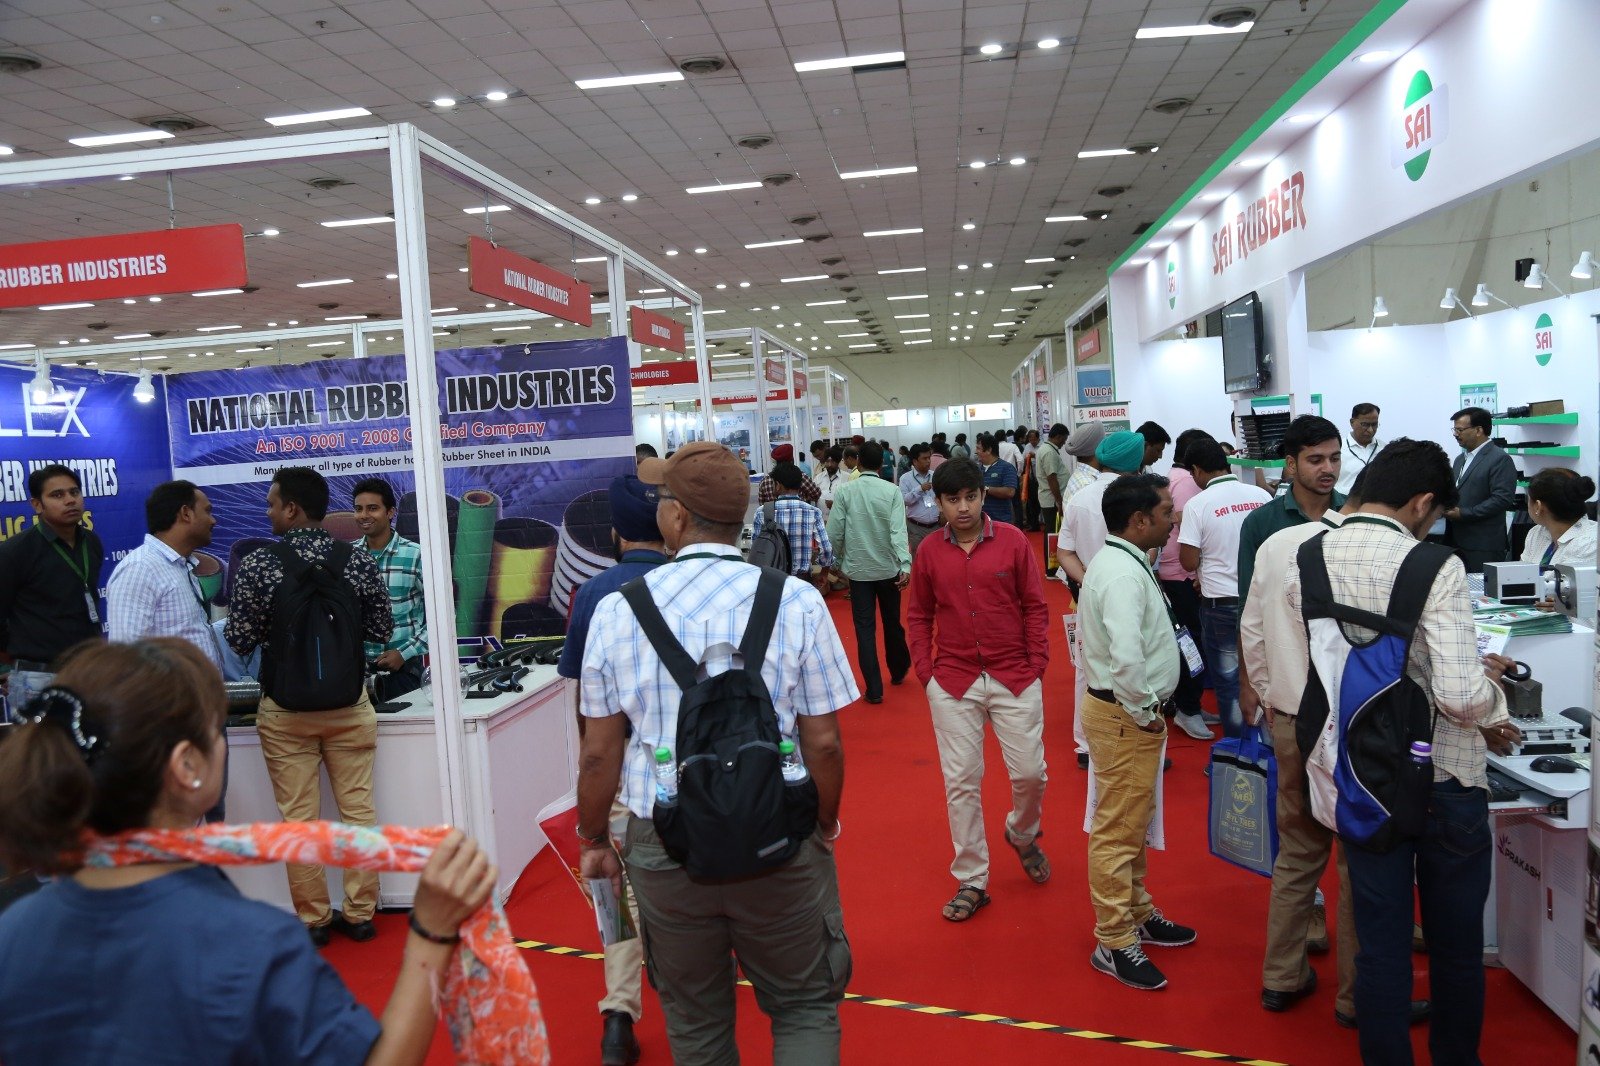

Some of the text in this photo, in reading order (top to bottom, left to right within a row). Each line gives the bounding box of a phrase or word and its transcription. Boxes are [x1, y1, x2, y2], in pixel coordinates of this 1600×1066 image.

[1405, 104, 1431, 149] SAI
[1212, 170, 1306, 276] SAI RUBBER
[0, 254, 167, 289] RUBBER INDUSTRIES
[1535, 331, 1552, 350] SAI
[186, 388, 321, 435] NATIONAL
[445, 364, 616, 415] INDUSTRIES
[1088, 408, 1126, 418] SAI RUBBER
[255, 439, 277, 454] An
[280, 435, 306, 452] ISO
[310, 432, 345, 450] 9001
[362, 428, 400, 446] 2008
[471, 421, 546, 439] Company
[318, 460, 330, 471] all
[333, 461, 353, 473] type
[356, 459, 365, 468] of
[368, 456, 401, 468] Rubber
[442, 451, 475, 462] Rubber
[477, 449, 505, 460] Sheet
[508, 448, 517, 458] in
[520, 446, 551, 457] INDIA
[1214, 507, 1229, 518] SAI
[1504, 848, 1541, 881] PRAKASH
